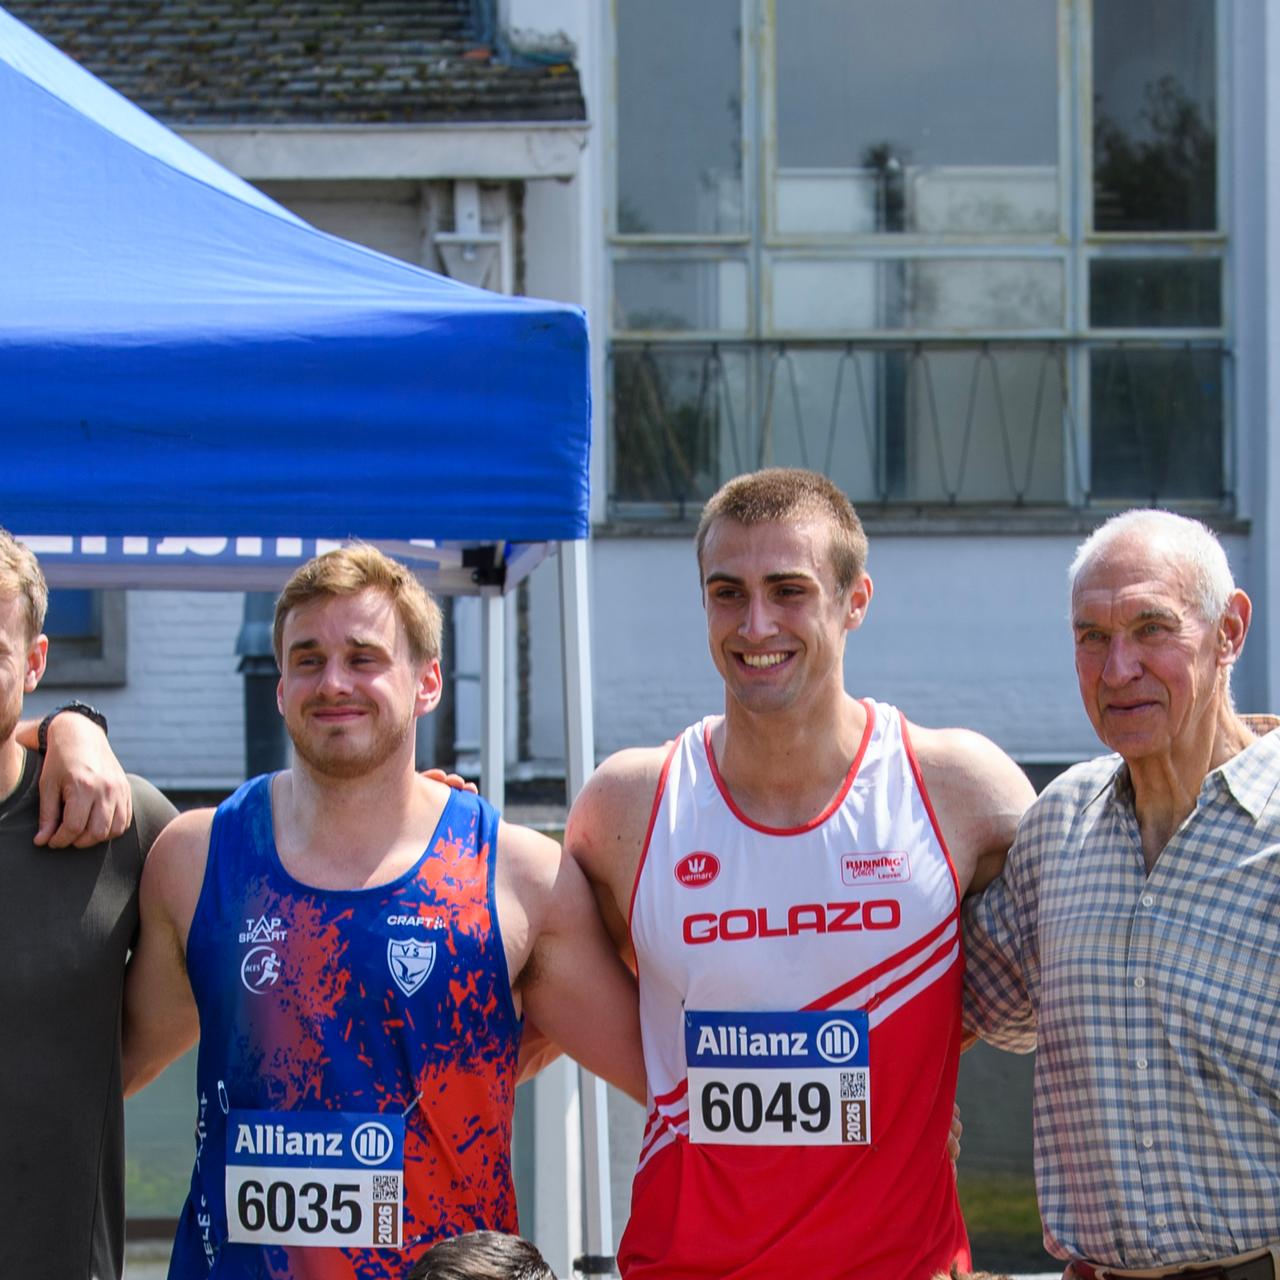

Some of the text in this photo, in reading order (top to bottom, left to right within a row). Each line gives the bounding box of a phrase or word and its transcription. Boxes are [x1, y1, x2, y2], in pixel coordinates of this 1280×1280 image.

[846, 856, 901, 870] RUNNING
[387, 915, 434, 927] CRAFT
[682, 899, 901, 946] GOLAZO
[696, 1025, 809, 1056] Allianz
[701, 1081, 831, 1133] 6049
[846, 1103, 861, 1141] 2026
[234, 1124, 343, 1157] Allianz
[237, 1180, 362, 1234] 6035
[378, 1205, 392, 1243] 2026
